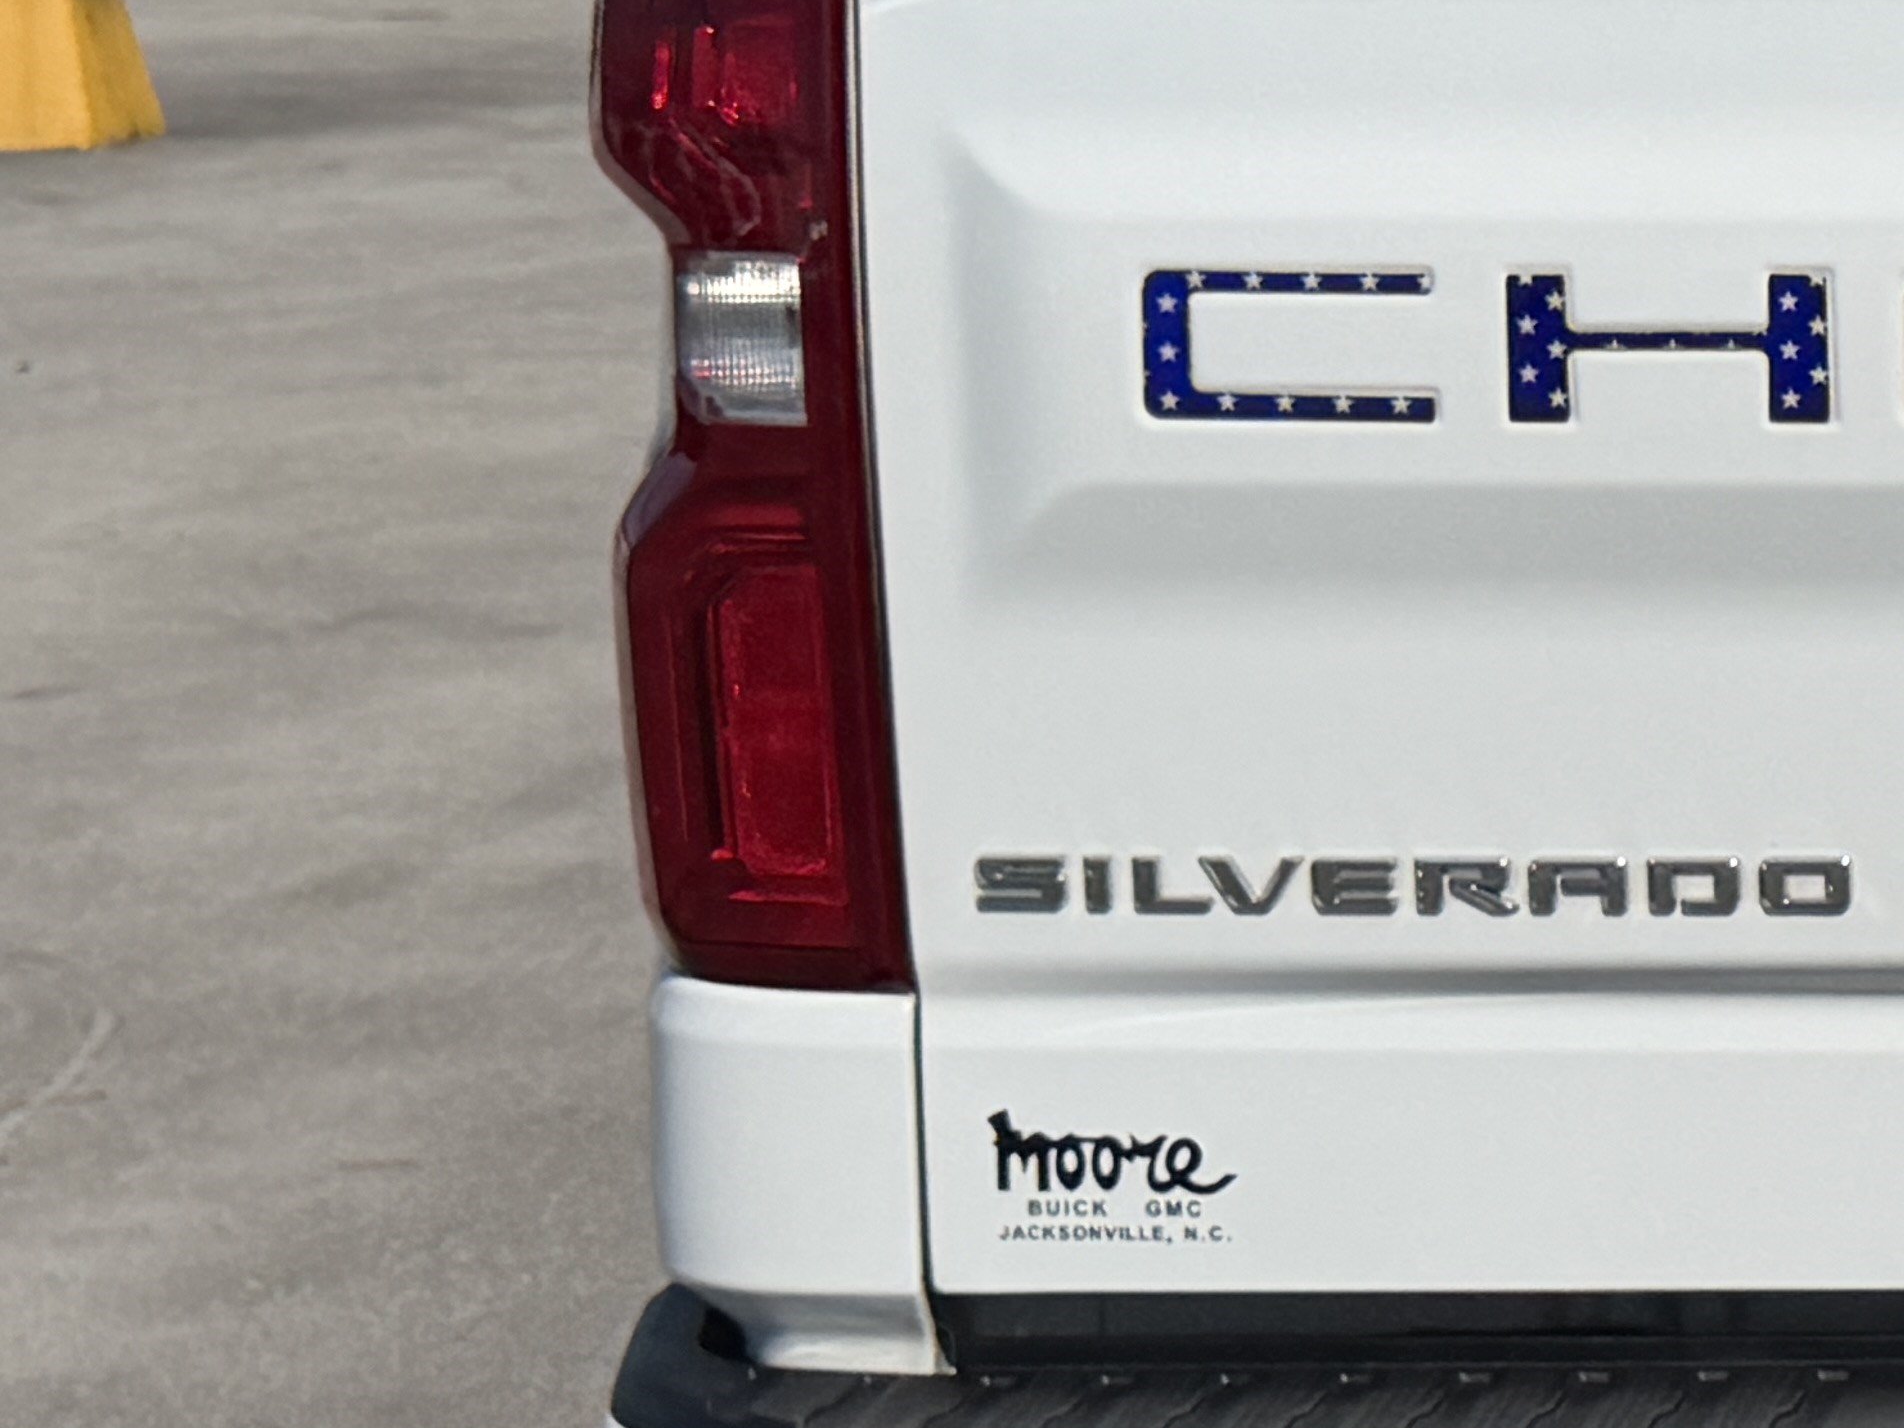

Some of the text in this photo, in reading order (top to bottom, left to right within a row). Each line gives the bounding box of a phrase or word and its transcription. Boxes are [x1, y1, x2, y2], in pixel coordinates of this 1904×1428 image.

[972, 853, 1854, 919] SILVERADO
[1026, 1198, 1202, 1217] BUICK GMC
[998, 1224, 1174, 1245] JACKSONVILLE,
